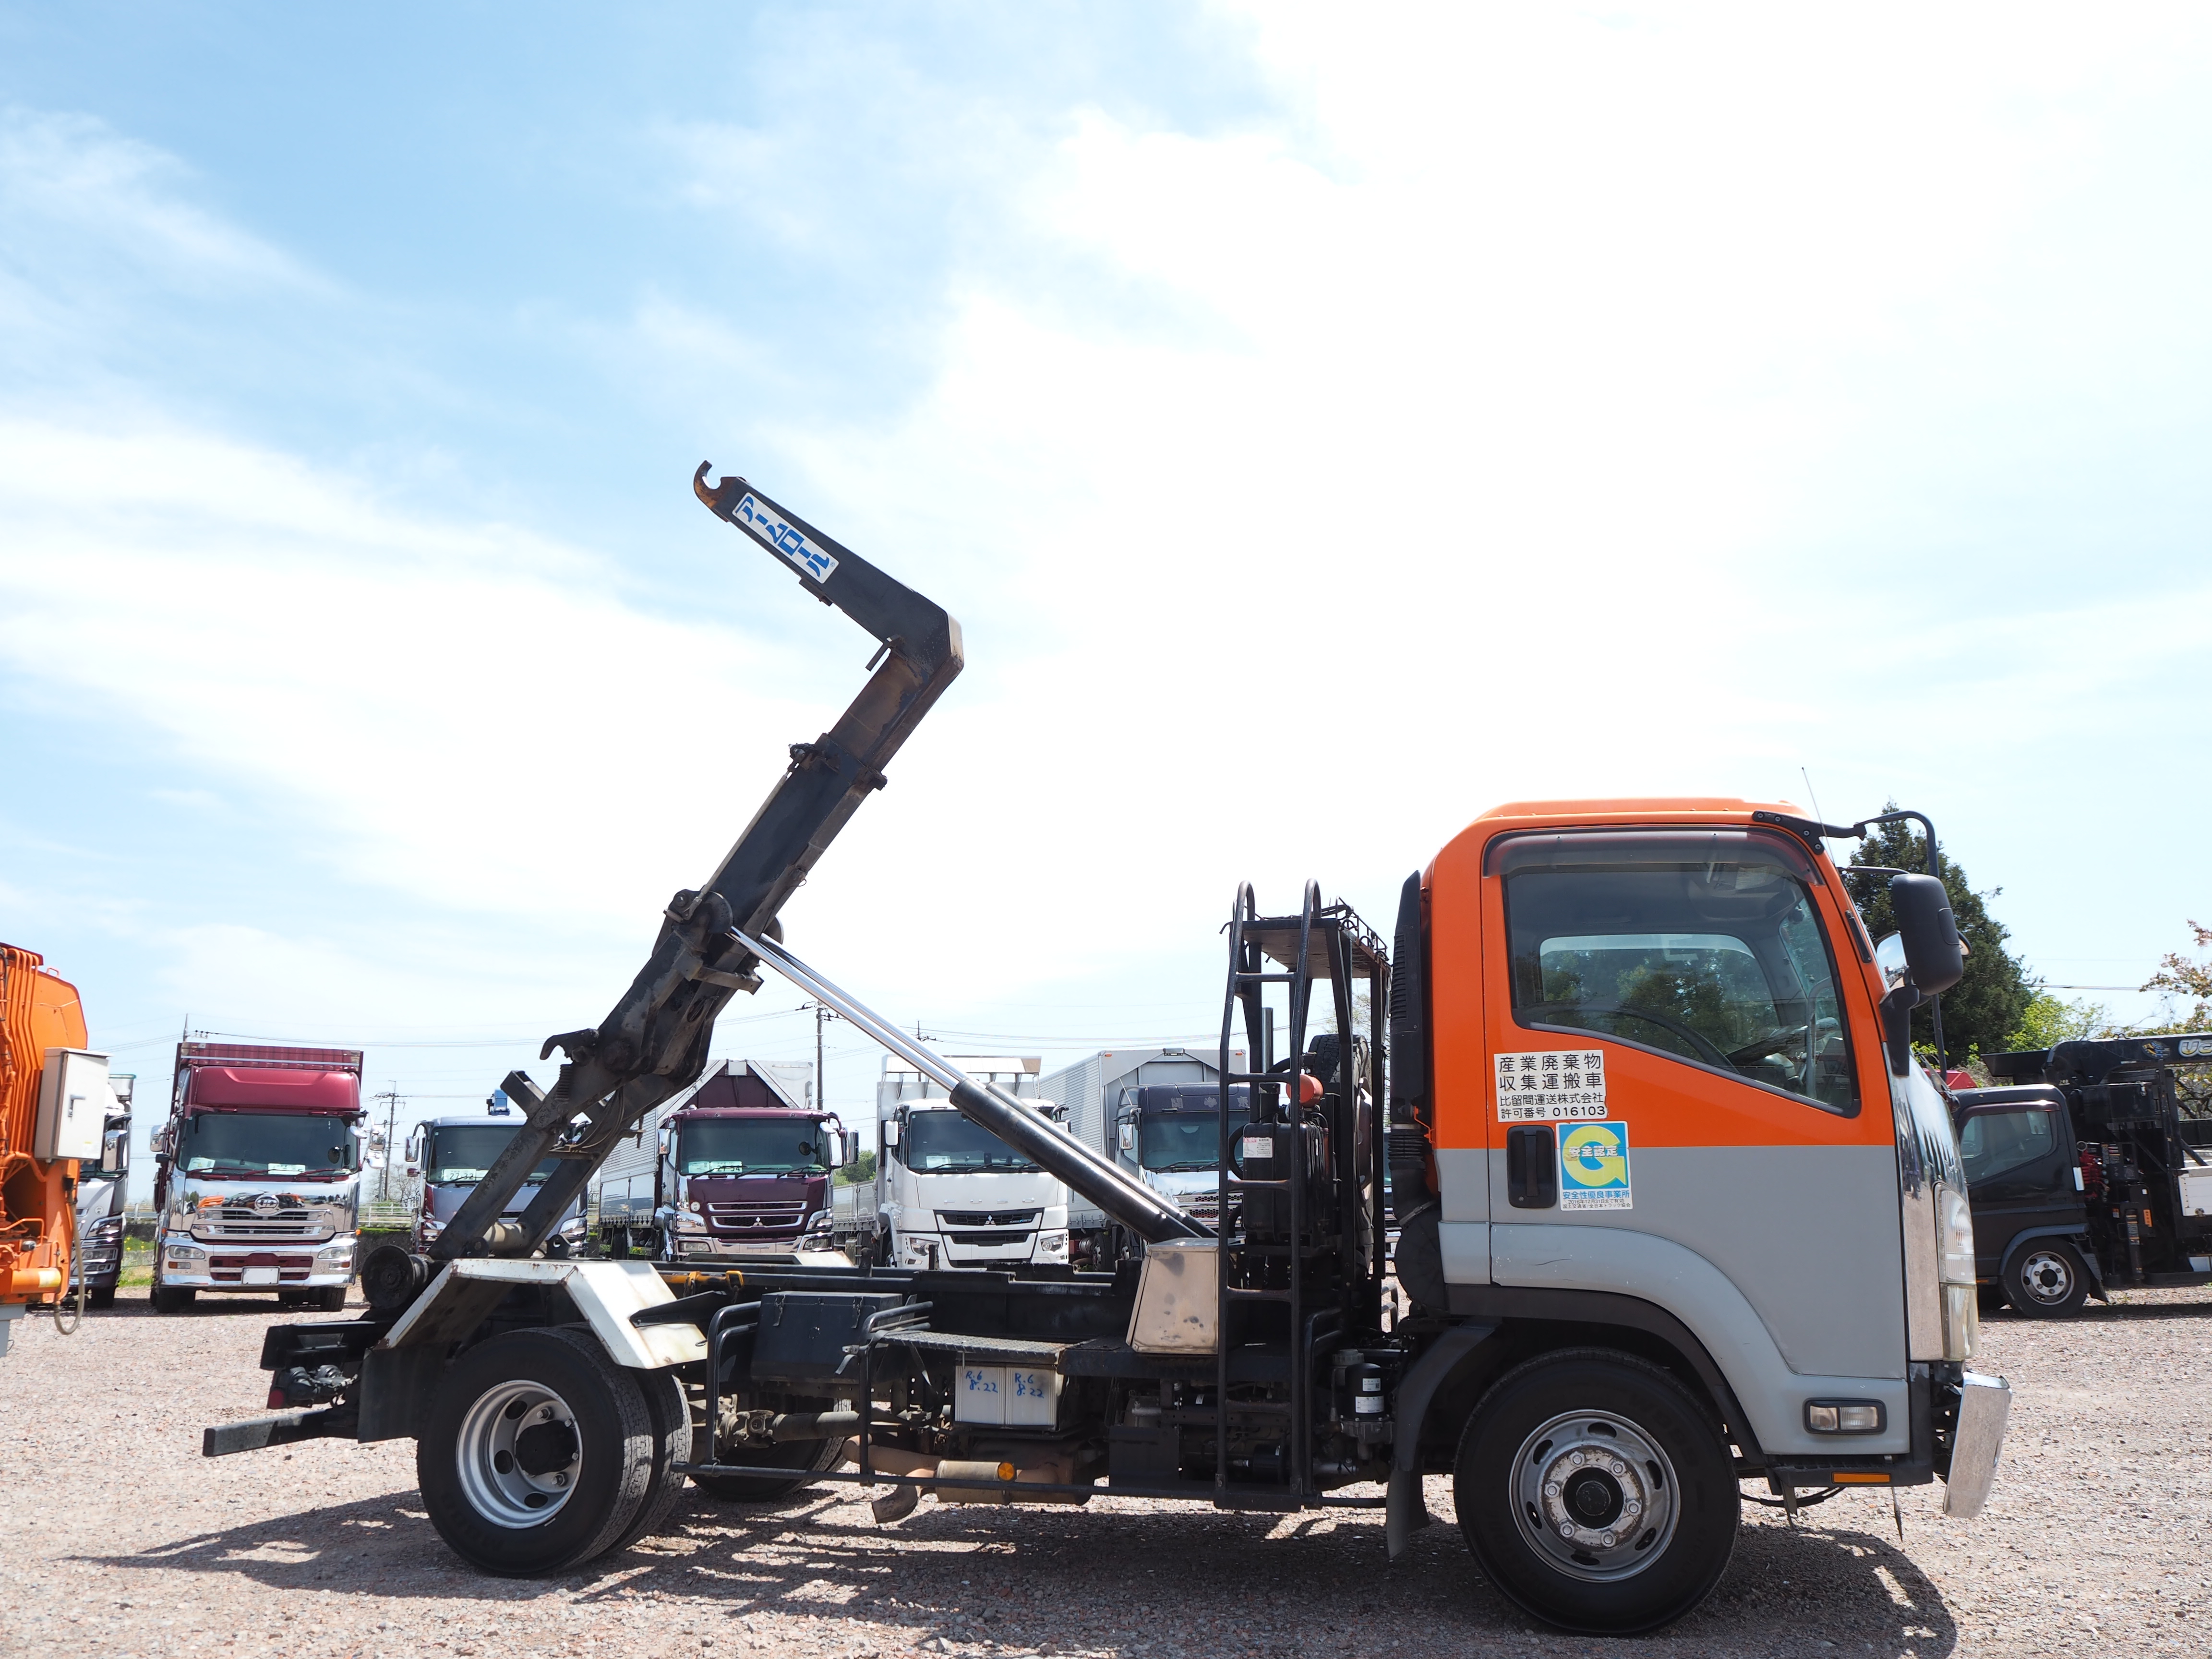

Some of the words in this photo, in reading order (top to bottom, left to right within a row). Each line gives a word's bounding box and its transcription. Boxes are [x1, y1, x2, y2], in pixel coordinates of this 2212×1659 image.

[735, 496, 830, 577] アームロール
[1499, 1053, 1601, 1072] 産業廃棄物
[1500, 1072, 1602, 1091] 収集運搬車
[1500, 1093, 1604, 1106] 比留間運送株式会社
[1501, 1107, 1546, 1119] 許可番号
[1553, 1106, 1605, 1117] 016103
[1569, 1146, 1619, 1157] 安全認定
[1563, 1190, 1630, 1199] 安全性優良事業所
[966, 1371, 982, 1381] R.6
[1015, 1373, 1034, 1383] R.6
